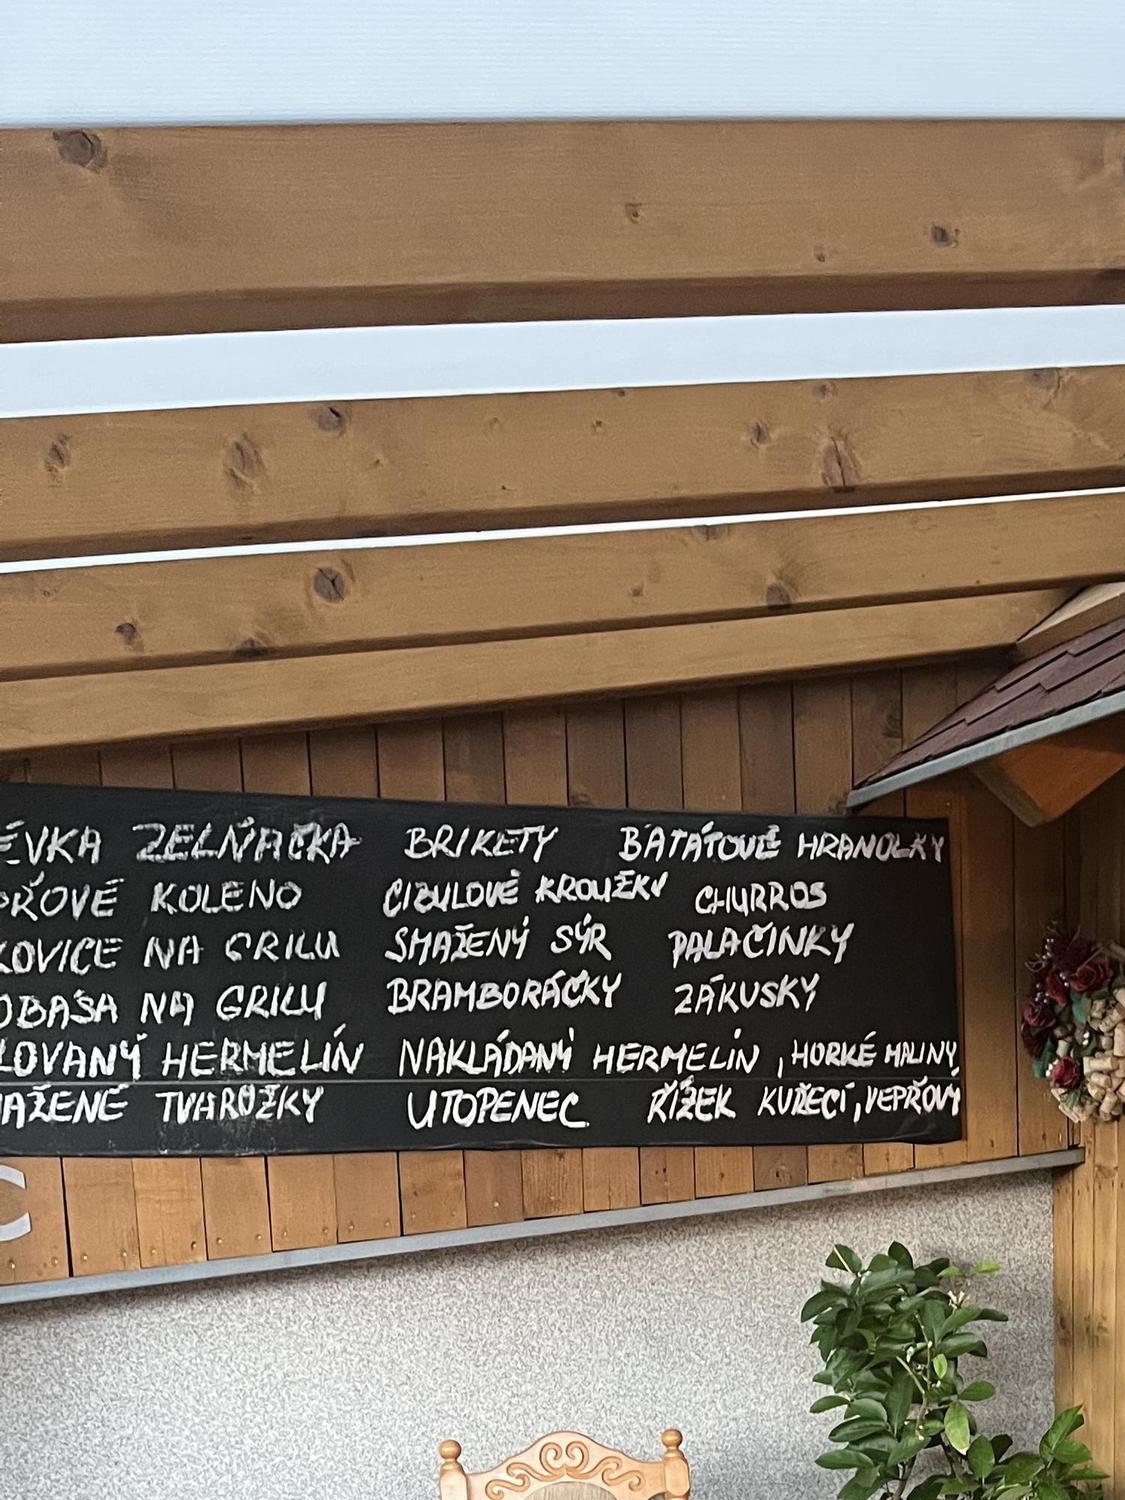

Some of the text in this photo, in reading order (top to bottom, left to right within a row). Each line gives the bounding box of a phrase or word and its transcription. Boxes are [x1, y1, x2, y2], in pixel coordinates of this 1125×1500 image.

[132, 815, 363, 865] ZELŇAČKA
[403, 823, 560, 864] BRIKETY
[796, 830, 947, 864] HRANOLKY
[150, 878, 303, 915] KOLENO
[694, 880, 828, 918] CHURROS
[143, 934, 204, 970] NA
[384, 912, 612, 966] SMAŽENÝ SÝR
[667, 921, 855, 969] PALAČINKY
[140, 990, 195, 1027] NA
[215, 981, 328, 1022] GRILU
[386, 969, 623, 1015] BRAMBORÁČKY
[674, 972, 821, 1016] ZÁKUSKY
[161, 1023, 365, 1080] HERMELÍN
[398, 1026, 575, 1078] NAKLÁDANÝ
[0, 1081, 130, 1130] AŽENÉ
[407, 1086, 591, 1131] UTOPENEC
